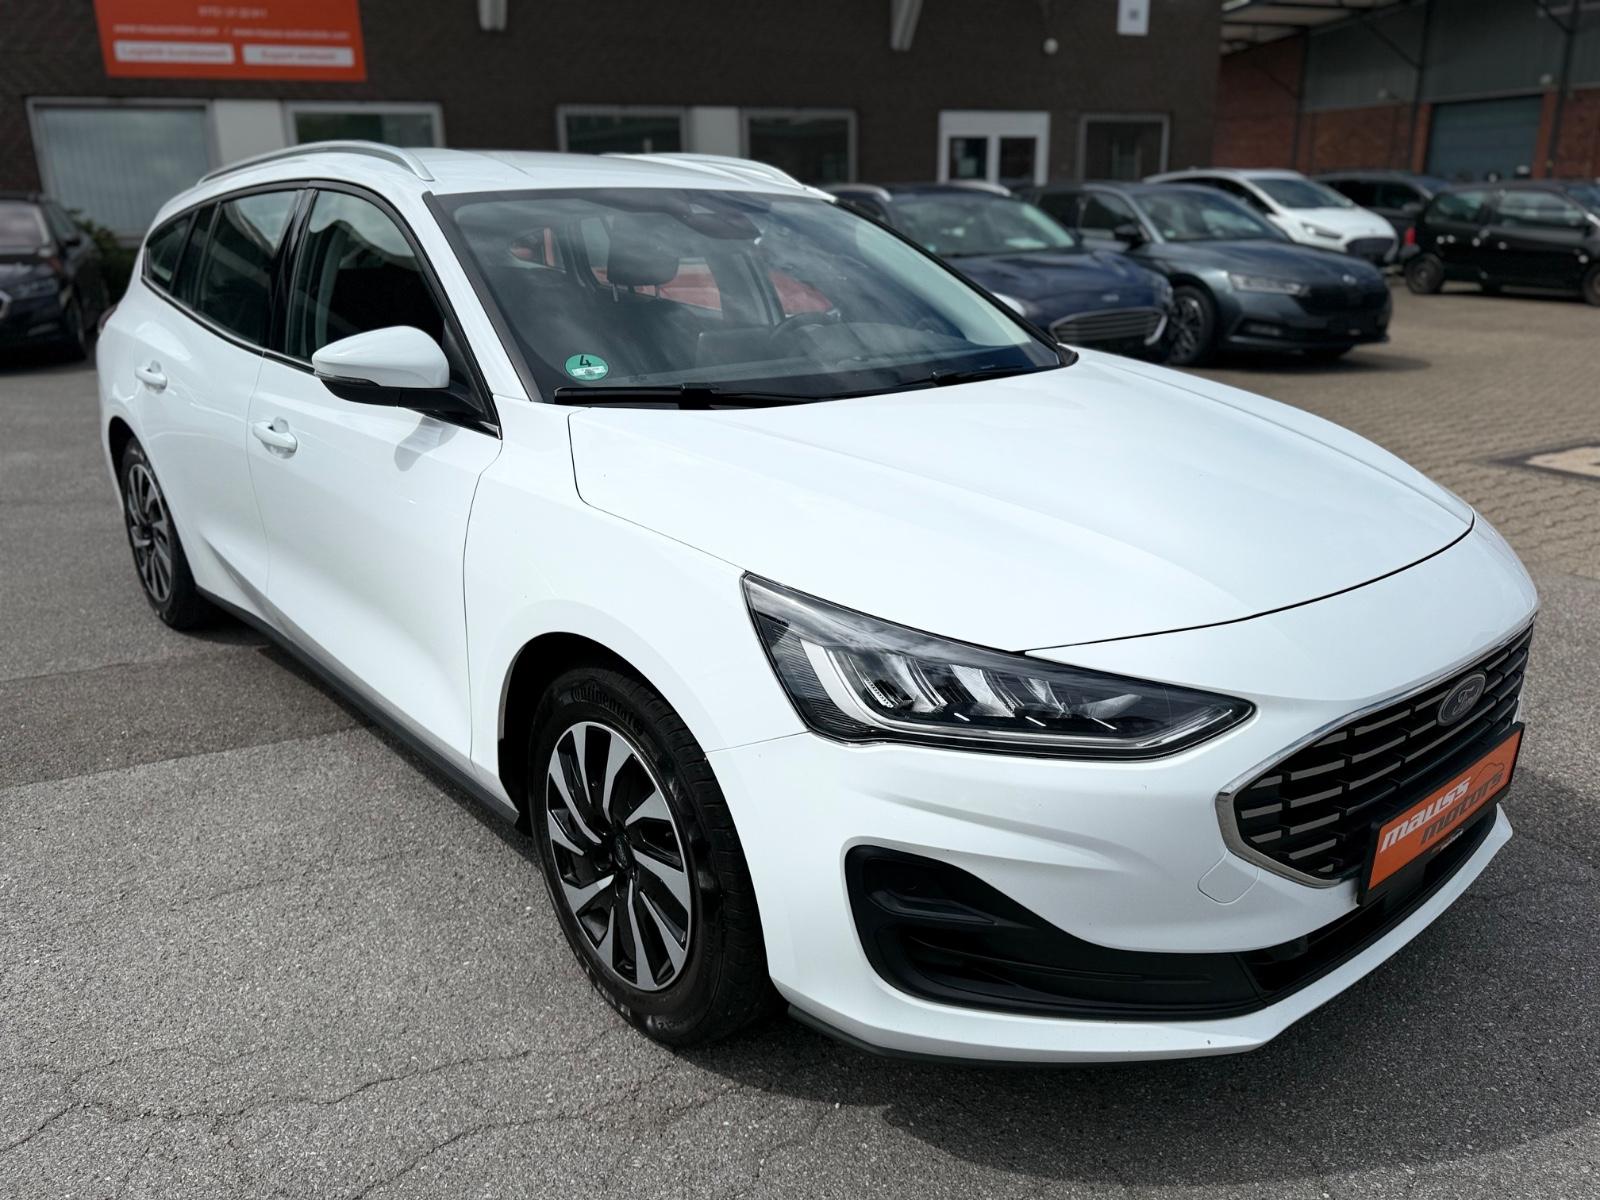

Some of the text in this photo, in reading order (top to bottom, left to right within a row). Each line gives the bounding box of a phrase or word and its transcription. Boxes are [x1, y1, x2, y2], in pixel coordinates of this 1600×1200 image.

[579, 354, 592, 367] 4
[1380, 776, 1471, 853] mauss
[1420, 772, 1503, 846] motors
